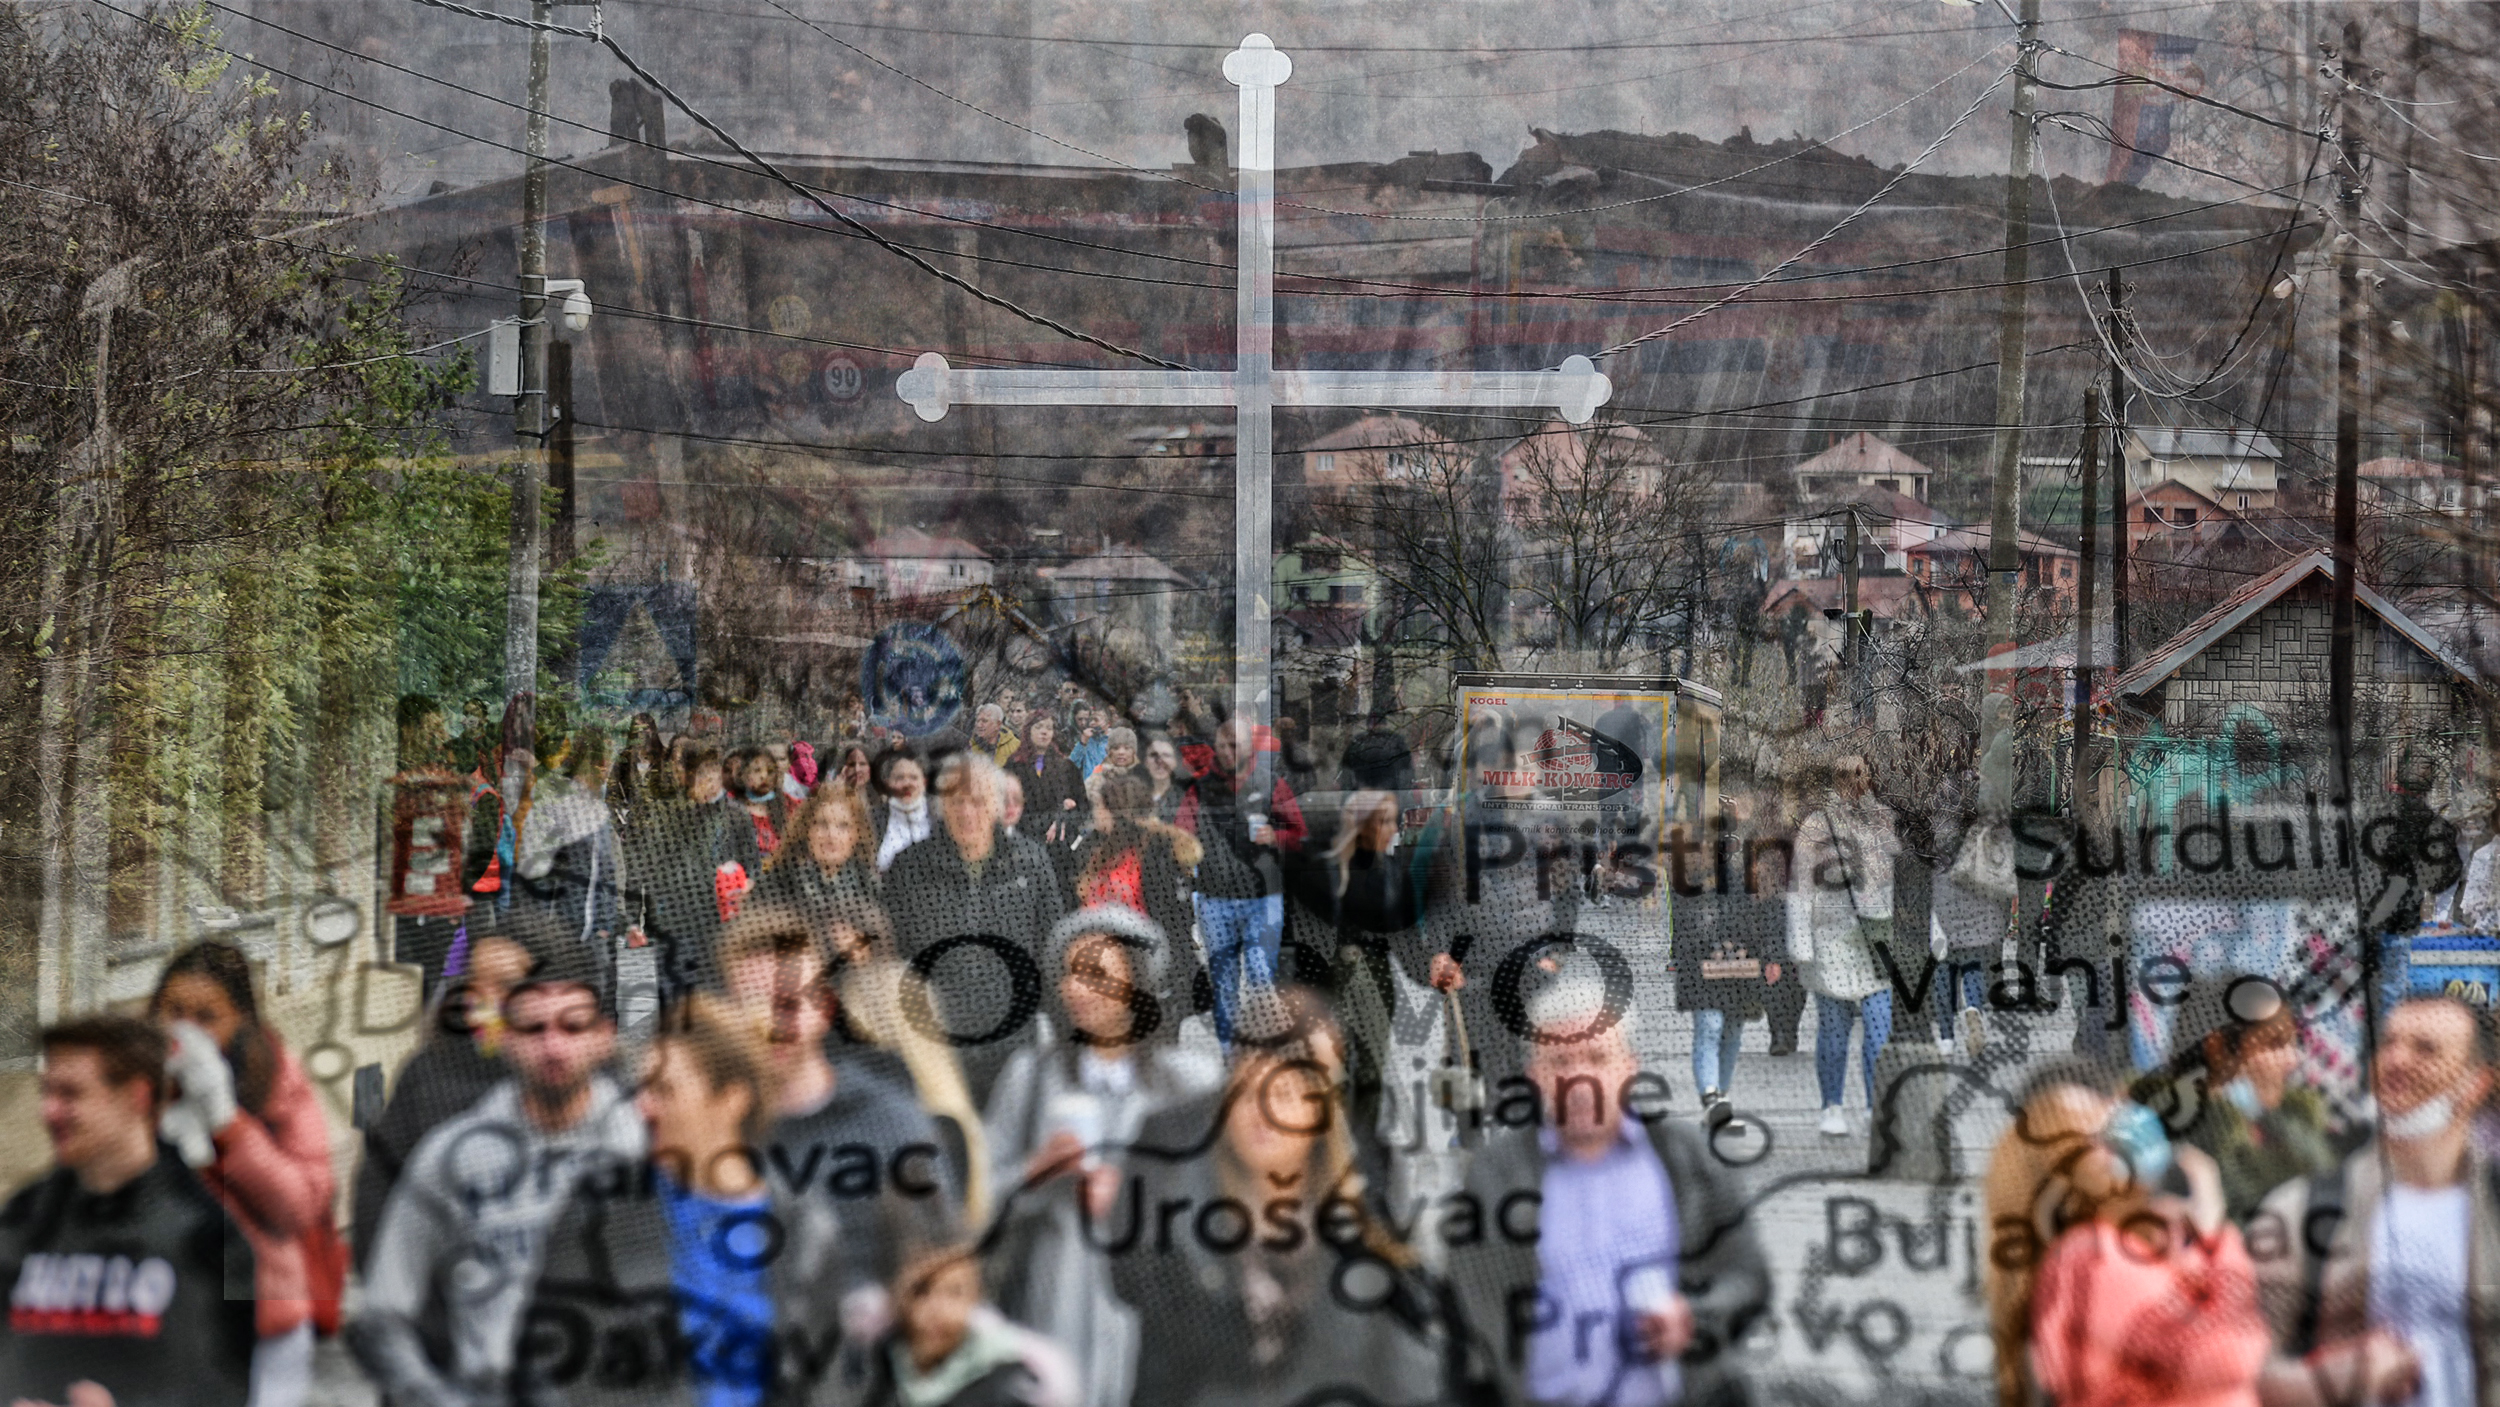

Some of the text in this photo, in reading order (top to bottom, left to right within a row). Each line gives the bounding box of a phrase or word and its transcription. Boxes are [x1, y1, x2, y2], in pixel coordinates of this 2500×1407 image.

[831, 365, 857, 388] 90
[1482, 770, 1634, 790] MILK-KOMERC
[1484, 801, 1626, 812] INTERNATIONAL TRANSPORT
[1874, 934, 2192, 1031] Vranje
